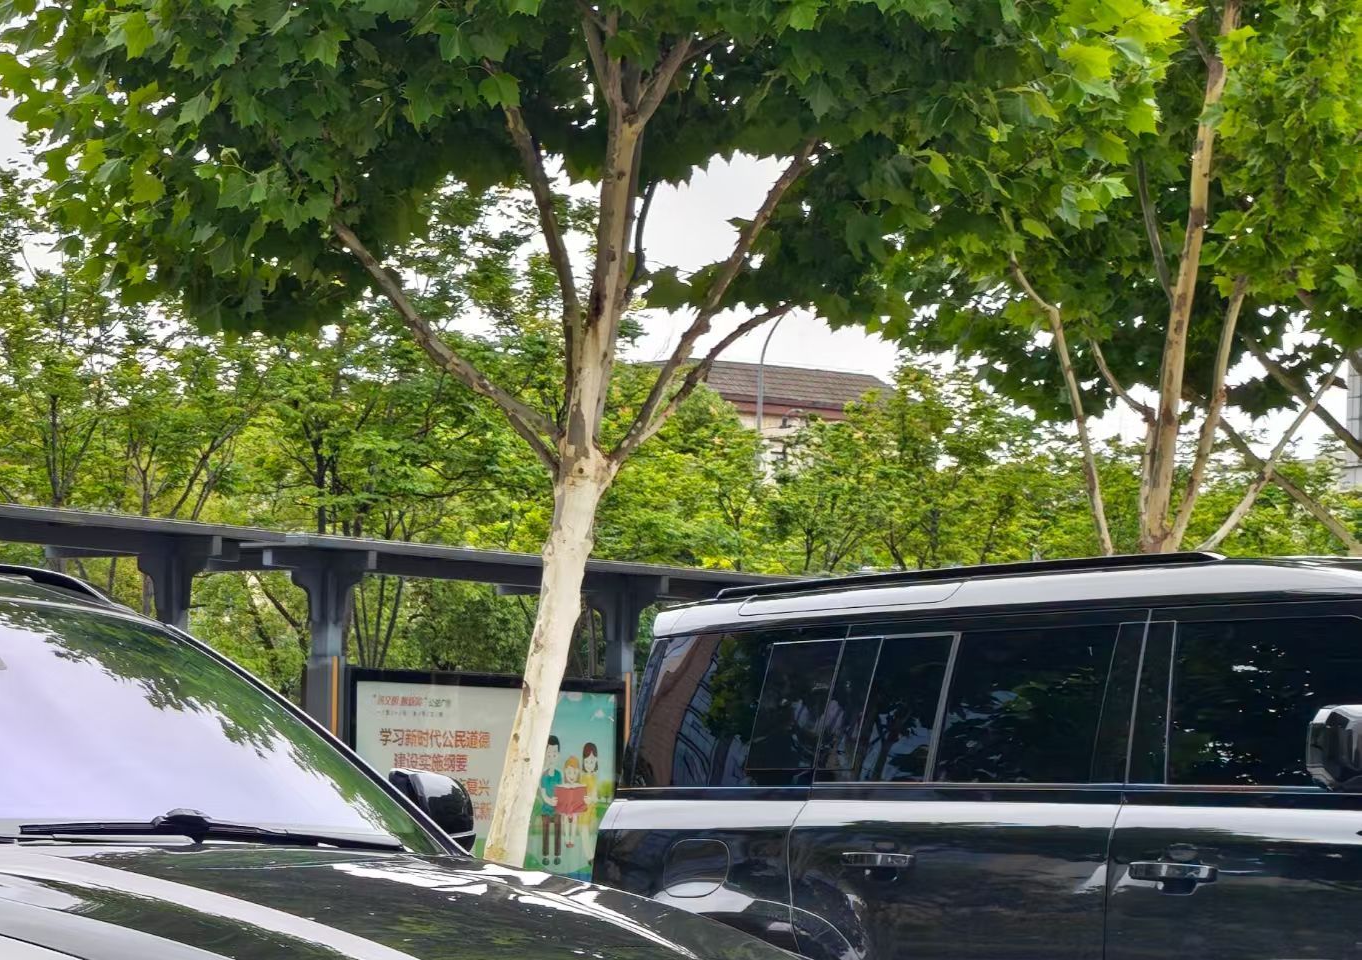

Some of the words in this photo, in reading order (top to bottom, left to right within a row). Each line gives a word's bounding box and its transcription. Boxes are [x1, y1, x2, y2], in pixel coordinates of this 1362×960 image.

[380, 728, 490, 748] 学习新时代公民道德
[394, 752, 468, 772] 建设实施纲要
